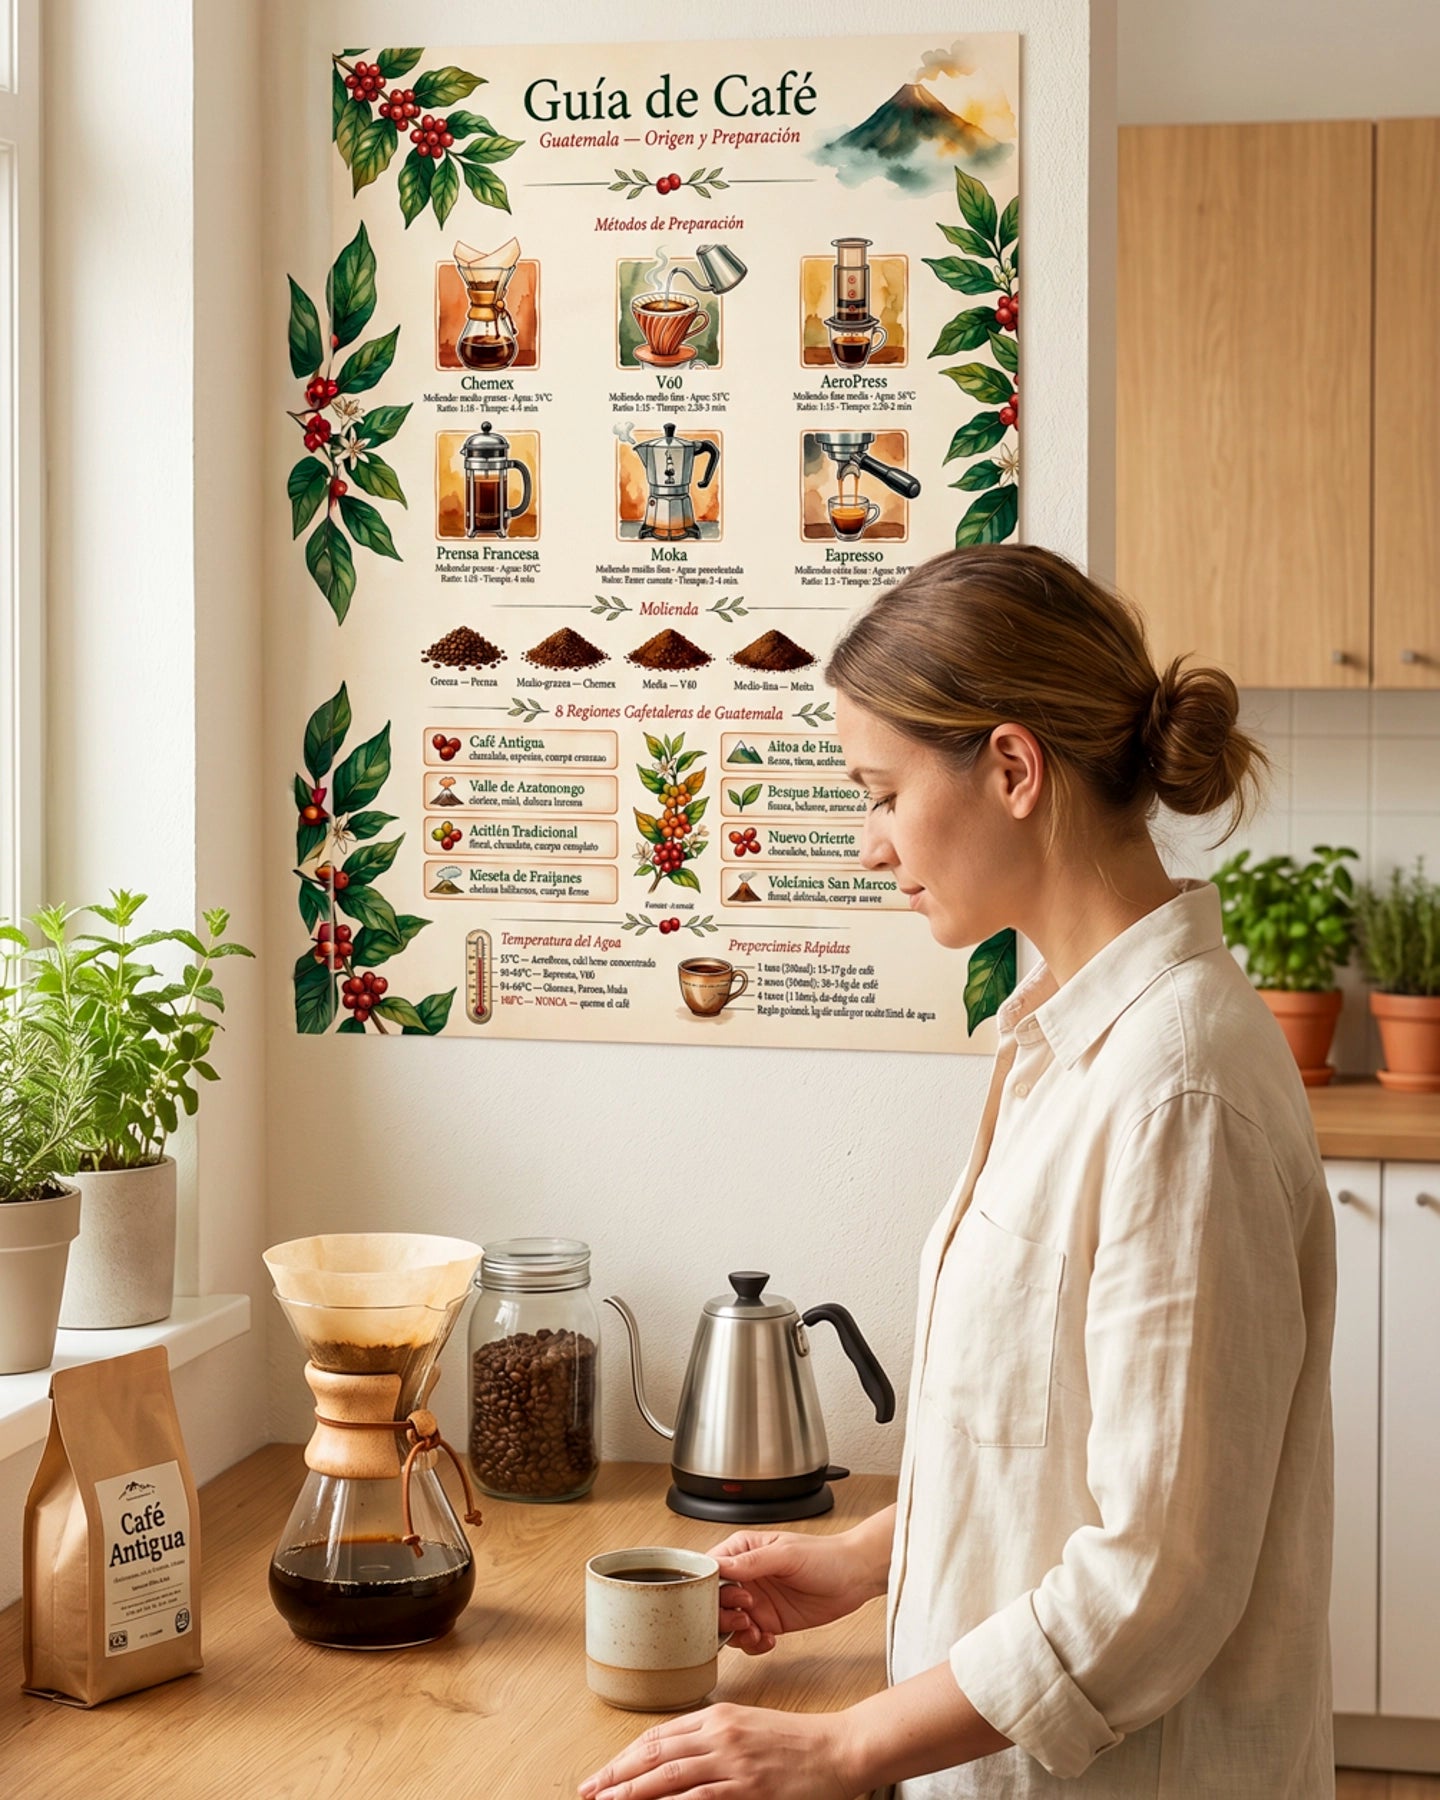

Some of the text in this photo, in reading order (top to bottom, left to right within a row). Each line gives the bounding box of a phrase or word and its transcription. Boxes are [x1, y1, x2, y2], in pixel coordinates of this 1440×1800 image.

[524, 70, 817, 121] Guía de Café
[540, 132, 619, 148] Guatemala
[645, 130, 694, 150] Origen
[698, 134, 708, 150] y
[712, 127, 800, 149] Preparación
[595, 215, 744, 234] Métodos de Preparación
[461, 376, 514, 390] Chemex
[821, 374, 887, 388] AeroPress
[437, 547, 539, 560] Prensa Francesa
[652, 547, 688, 561] Moka
[640, 602, 698, 616] Molienda
[555, 705, 563, 717] 8
[567, 704, 620, 721] Regiones
[697, 705, 711, 719] de
[715, 706, 783, 720] Guatemala
[470, 735, 545, 752] Café Antigua
[802, 741, 816, 753] de
[469, 780, 498, 792] Valle
[500, 781, 514, 792] de
[512, 825, 577, 838] Tradicional
[768, 831, 806, 844] Nuevo
[514, 869, 527, 882] de
[530, 871, 582, 887] Fraijanes
[828, 877, 850, 889] San
[853, 877, 897, 890] Marcos
[502, 932, 572, 949] Temperatura
[574, 934, 592, 947] del
[758, 963, 762, 972] 1
[757, 977, 762, 986] 2
[758, 992, 762, 1000] 4
[121, 1501, 166, 1536] Café
[109, 1530, 186, 1567] Antigua
